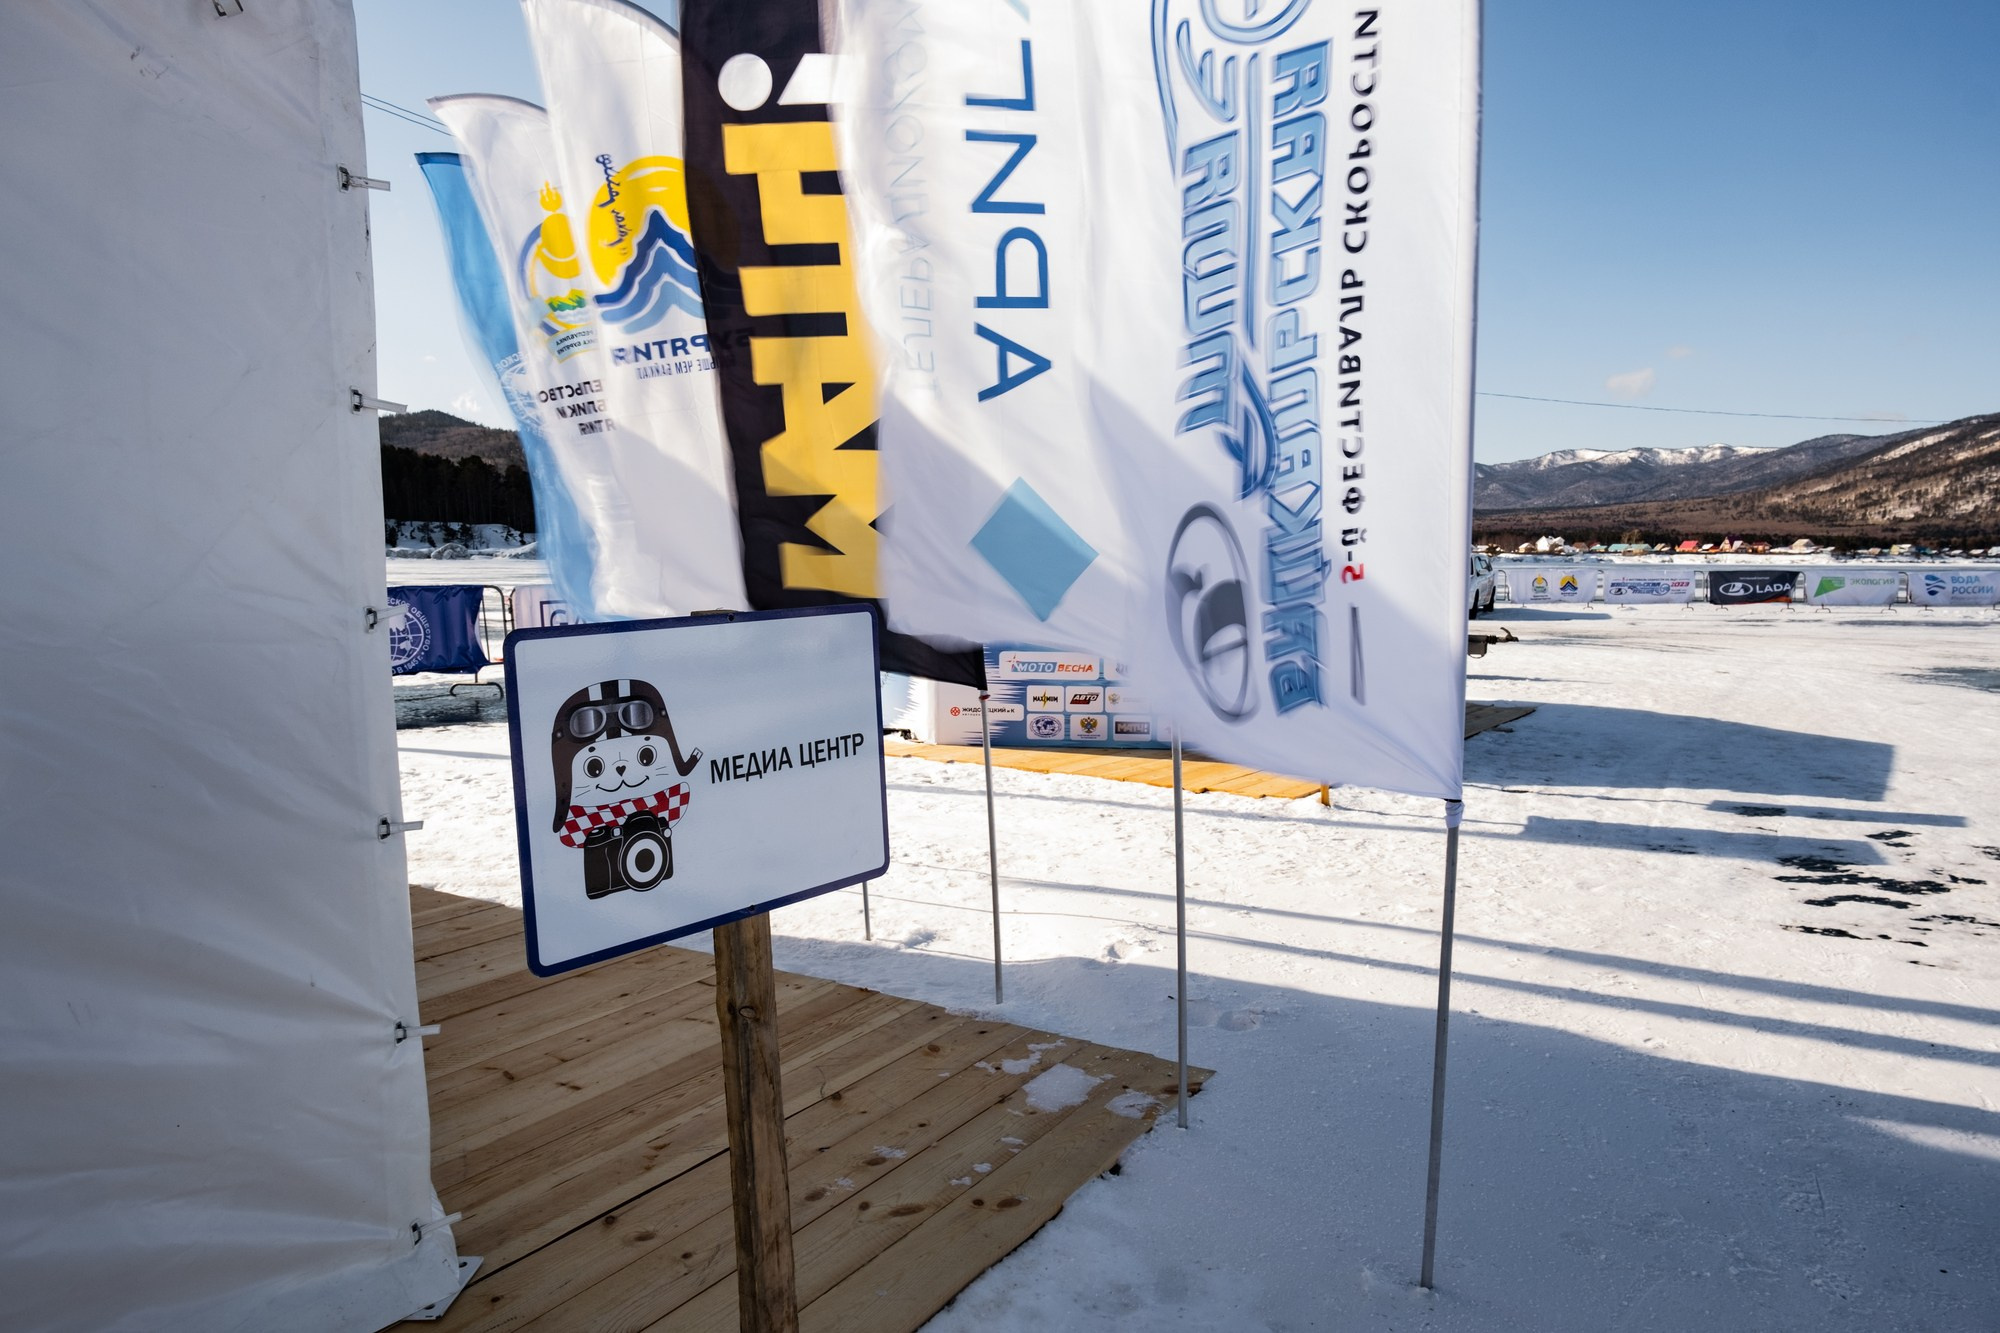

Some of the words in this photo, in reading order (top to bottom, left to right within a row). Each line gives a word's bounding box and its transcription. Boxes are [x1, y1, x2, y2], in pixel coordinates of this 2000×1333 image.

[1850, 578, 1895, 586] ЭКОЛОГИЯ
[1951, 576, 1980, 584] ВОДА
[1756, 583, 1792, 593] LADA
[1952, 586, 1993, 594] РОССИИ
[411, 606, 431, 651] ОБЩЕСТВО
[1017, 662, 1054, 672] МОТО
[1057, 663, 1094, 673] ВЕСНА
[710, 747, 793, 784] МЕДИА
[800, 732, 865, 769] ЦЕНТР
